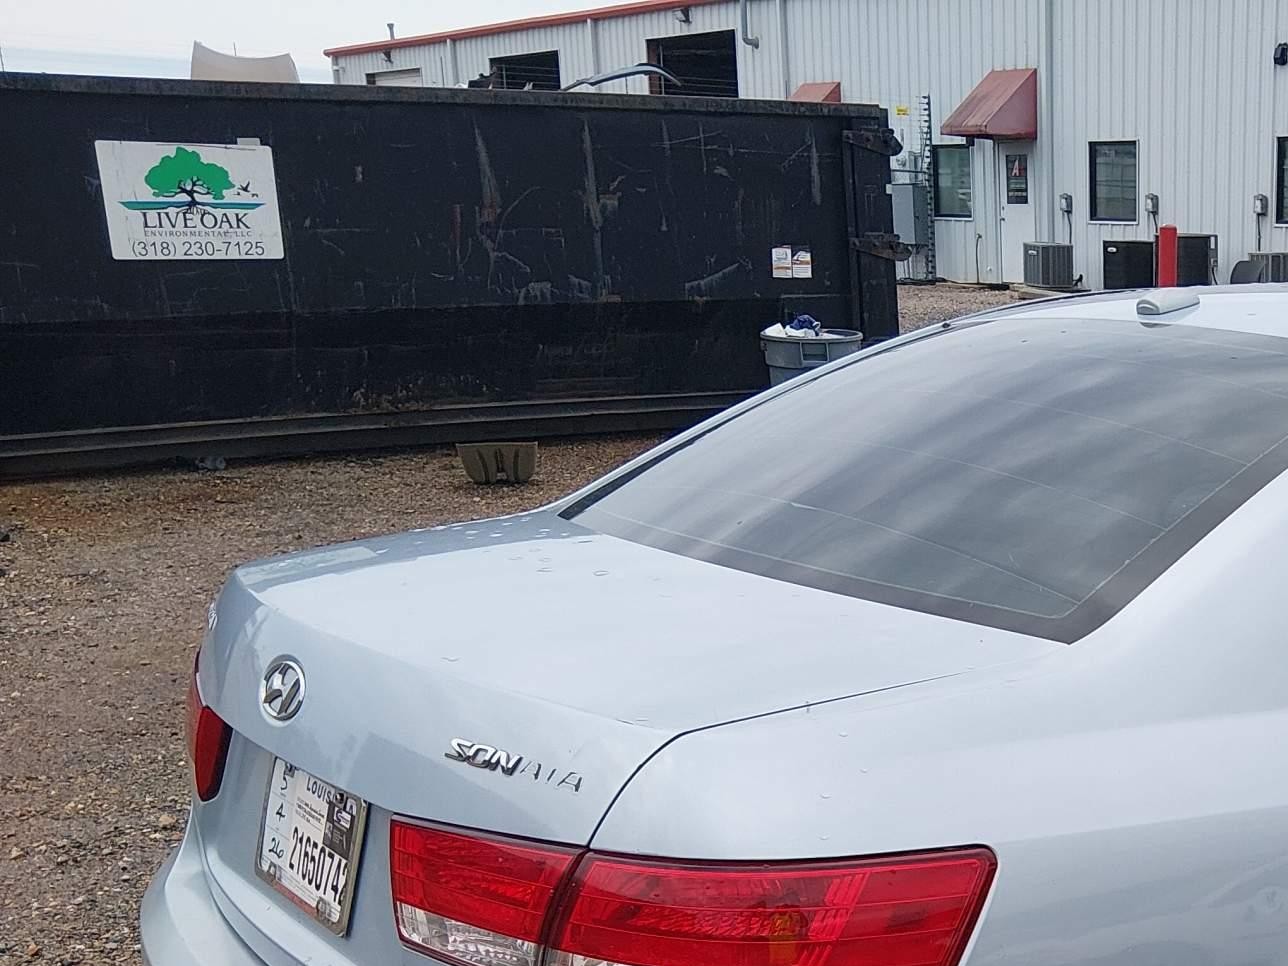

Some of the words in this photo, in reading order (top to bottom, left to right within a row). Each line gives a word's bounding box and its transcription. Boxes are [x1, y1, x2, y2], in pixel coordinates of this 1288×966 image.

[142, 211, 197, 229] LIVE
[201, 212, 251, 229] OAK
[132, 240, 177, 258] (318)
[182, 241, 265, 257] 230-7125
